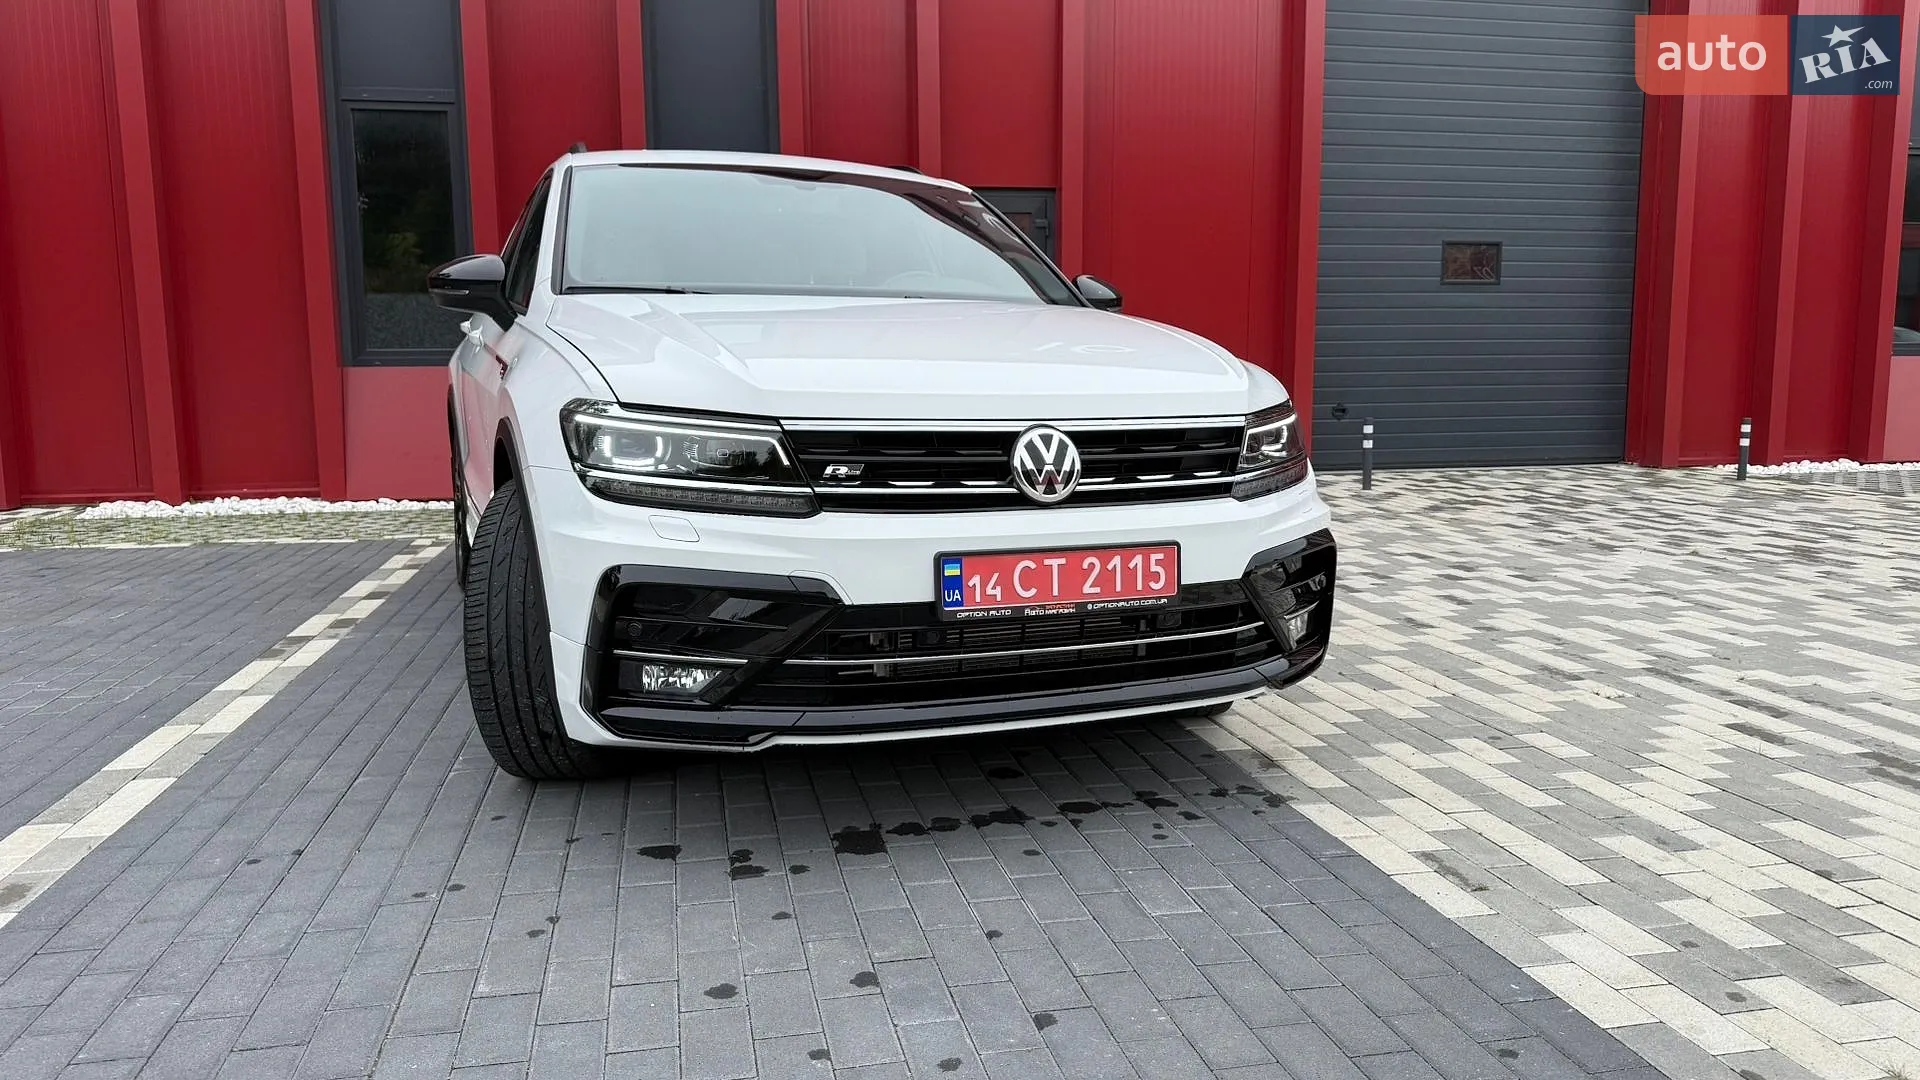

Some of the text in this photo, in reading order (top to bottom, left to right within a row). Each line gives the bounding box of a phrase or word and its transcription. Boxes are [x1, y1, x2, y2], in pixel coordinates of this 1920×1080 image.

[1013, 428, 1081, 500] VW
[968, 553, 1166, 603] 14 CT 2115
[944, 590, 962, 602] UA
[956, 609, 1012, 618] OPTION AUTO
